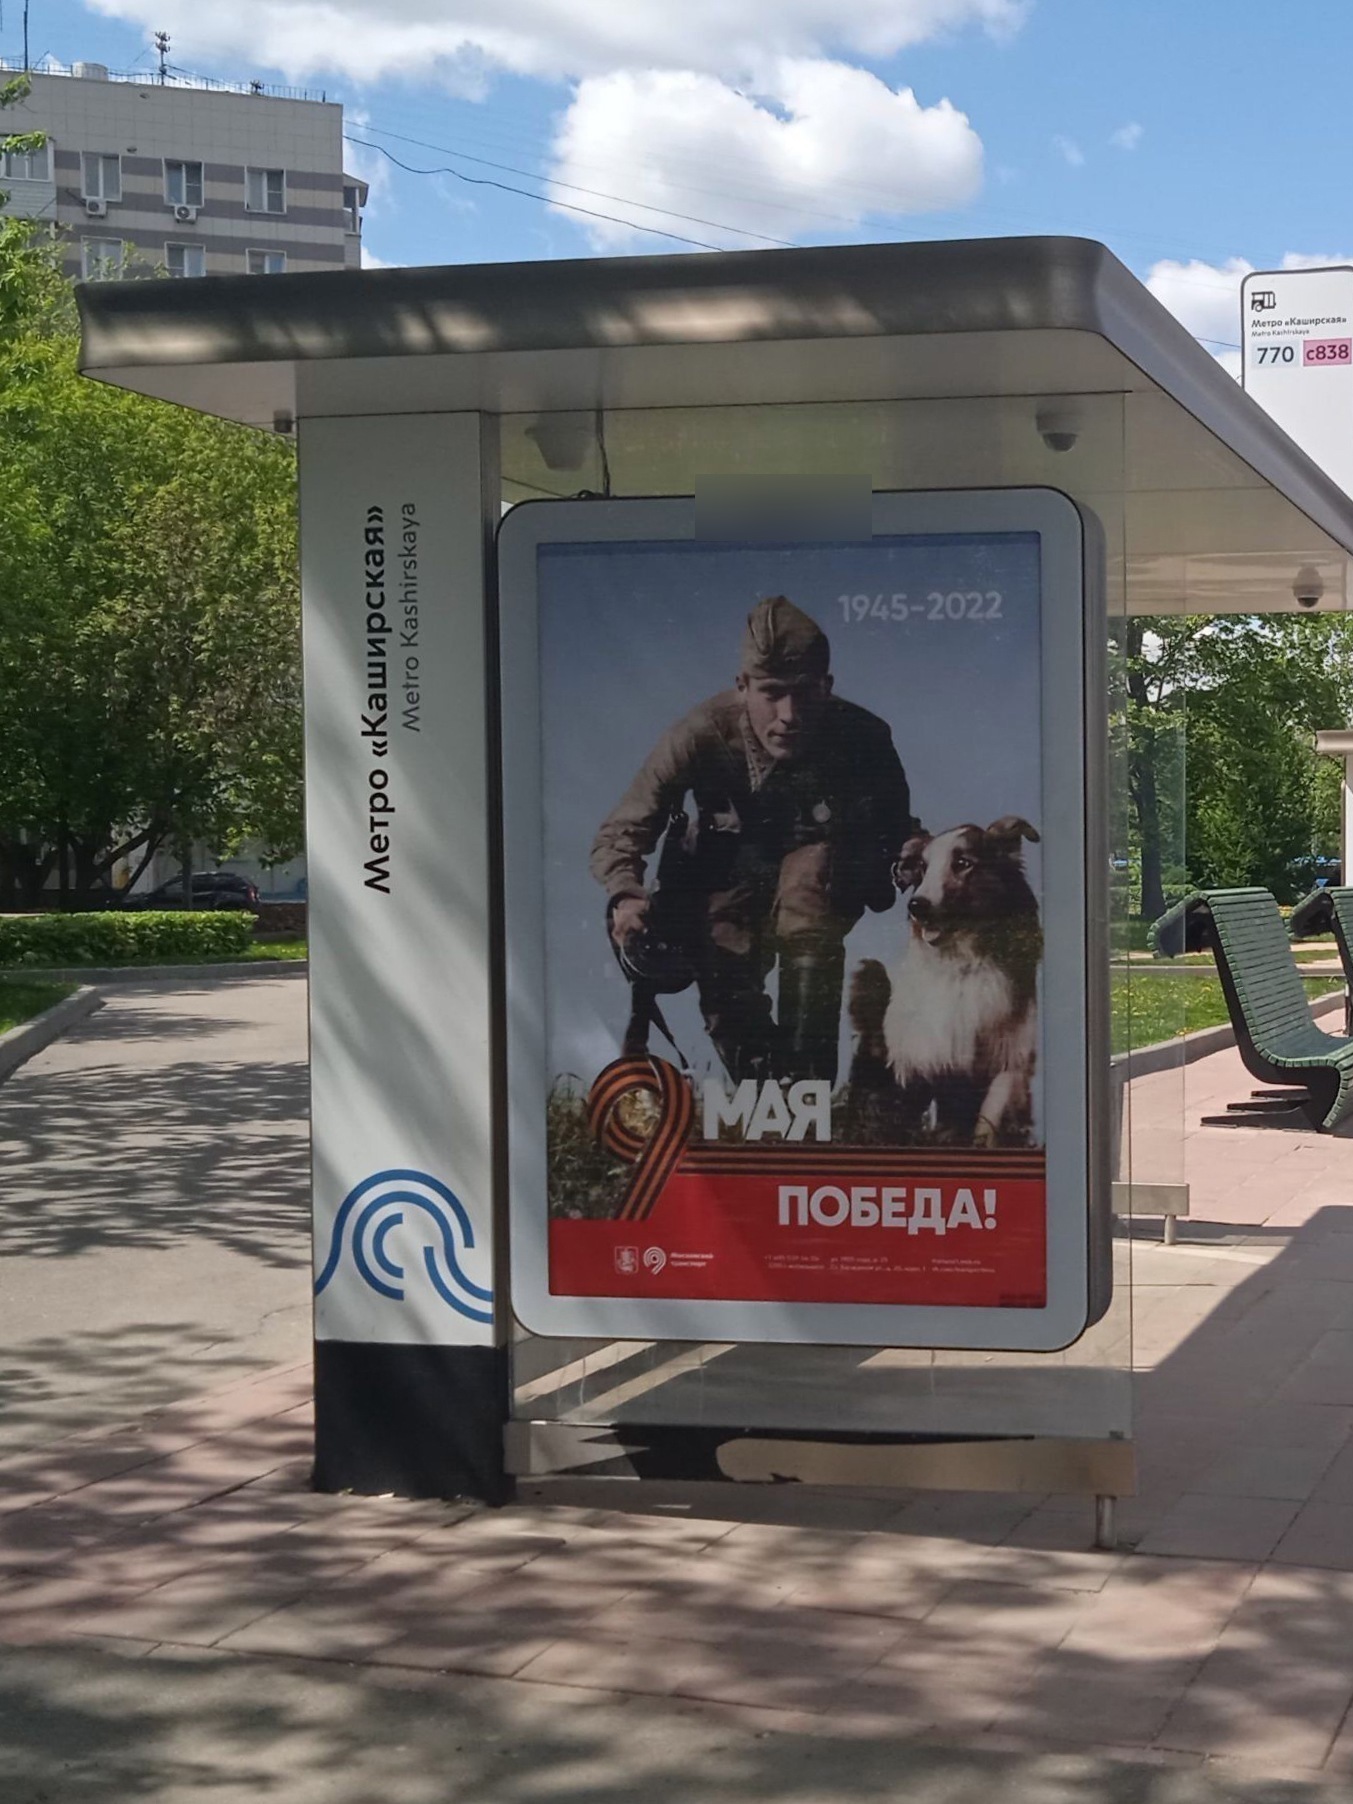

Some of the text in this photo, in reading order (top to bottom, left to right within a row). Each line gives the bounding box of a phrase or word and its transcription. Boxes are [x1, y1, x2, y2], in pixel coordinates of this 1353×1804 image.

[1251, 316, 1347, 329] Метро «Каширская»
[1257, 346, 1295, 364] 770
[1306, 343, 1350, 361] с838
[397, 502, 421, 732] Metro Kashirskaya
[838, 591, 1003, 623] 1945-2022
[361, 504, 395, 894] Метро «Каширская»
[703, 1079, 832, 1142] МАЯ
[777, 1185, 998, 1236] ПОБЕДА!
